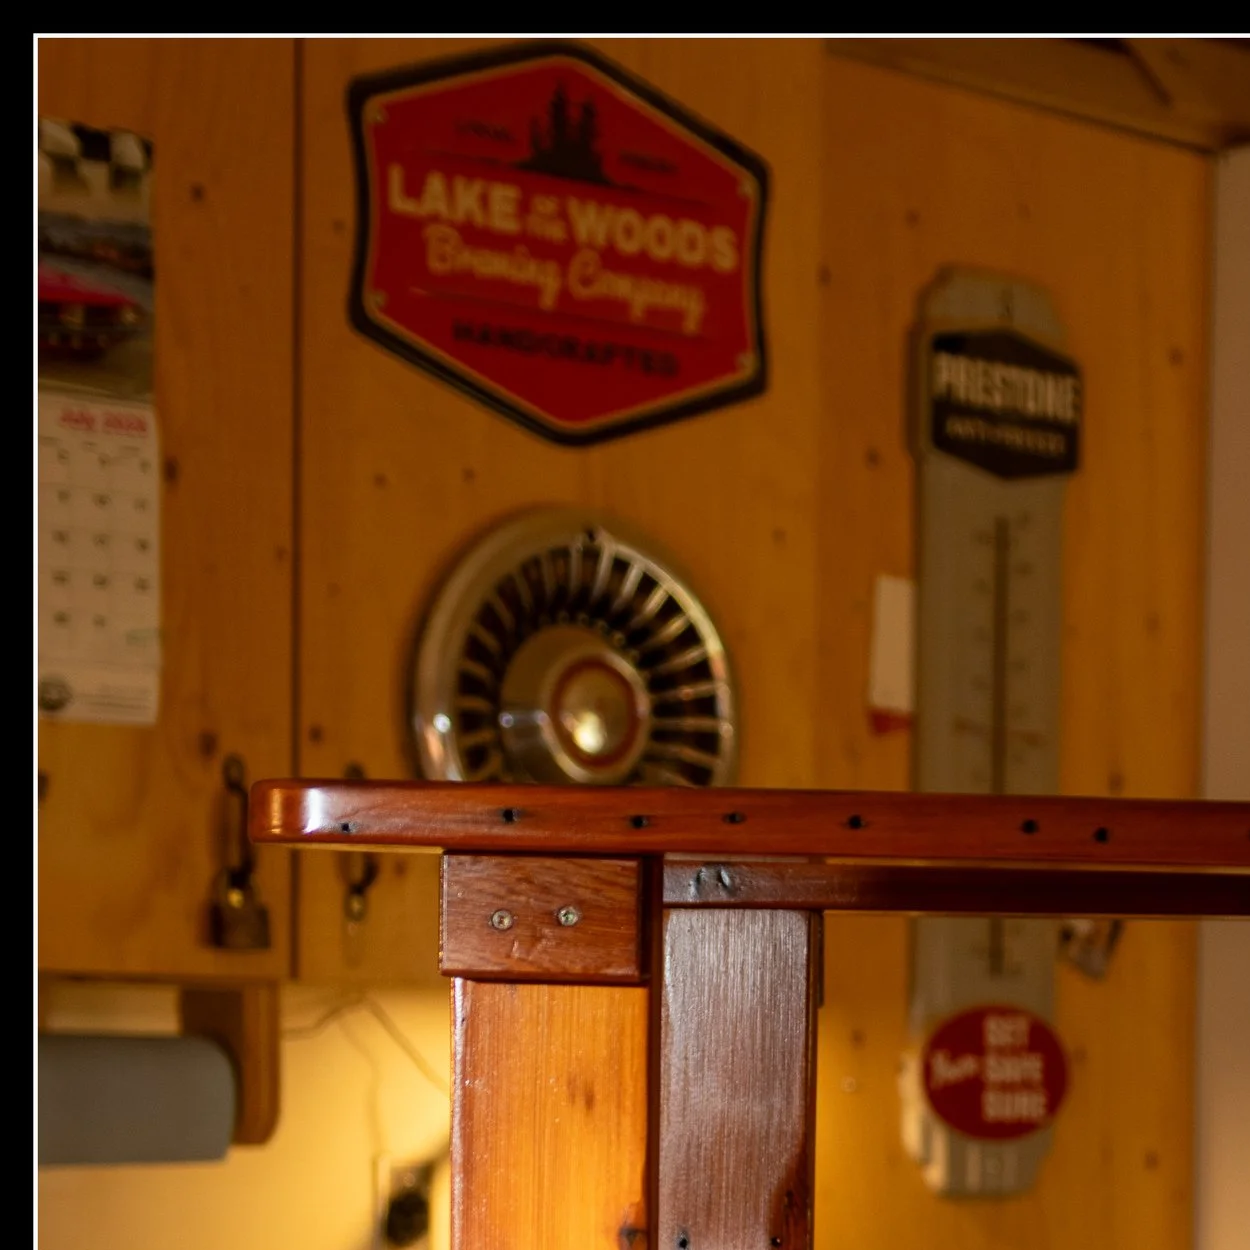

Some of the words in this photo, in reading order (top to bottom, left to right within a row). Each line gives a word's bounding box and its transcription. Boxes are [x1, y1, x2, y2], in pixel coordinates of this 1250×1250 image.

[387, 162, 522, 233] LAKE
[567, 195, 739, 273] WOODS
[422, 222, 561, 311] Brewing
[568, 247, 707, 337] Company
[452, 319, 679, 376] HANDCRAFTED
[932, 352, 1077, 423] PRESTONE
